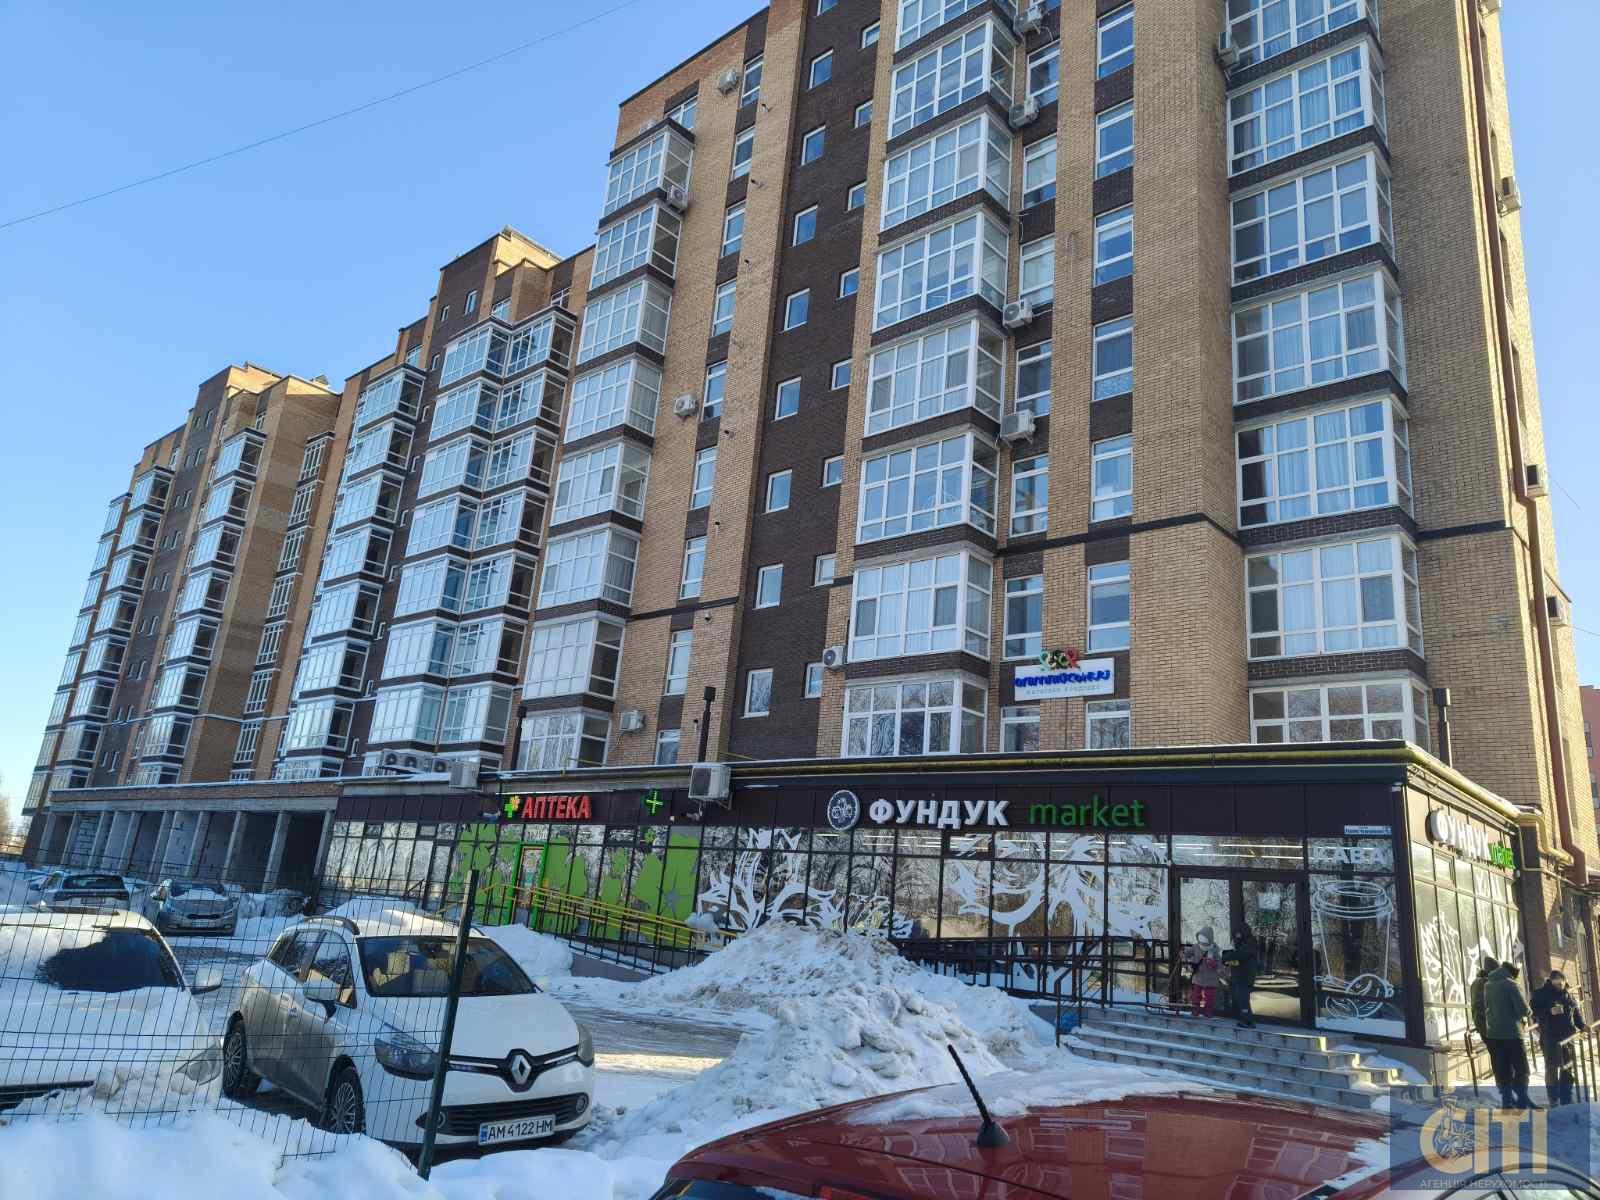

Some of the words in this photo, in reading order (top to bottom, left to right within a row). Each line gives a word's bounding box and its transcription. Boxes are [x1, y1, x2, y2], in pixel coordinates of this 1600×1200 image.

[521, 795, 592, 819] АПТЕКА
[869, 798, 1009, 829] ФУНДУК
[1029, 795, 1145, 827] market
[488, 1126, 505, 1140] AM
[508, 1122, 535, 1137] 4122
[536, 1120, 552, 1133] HM
